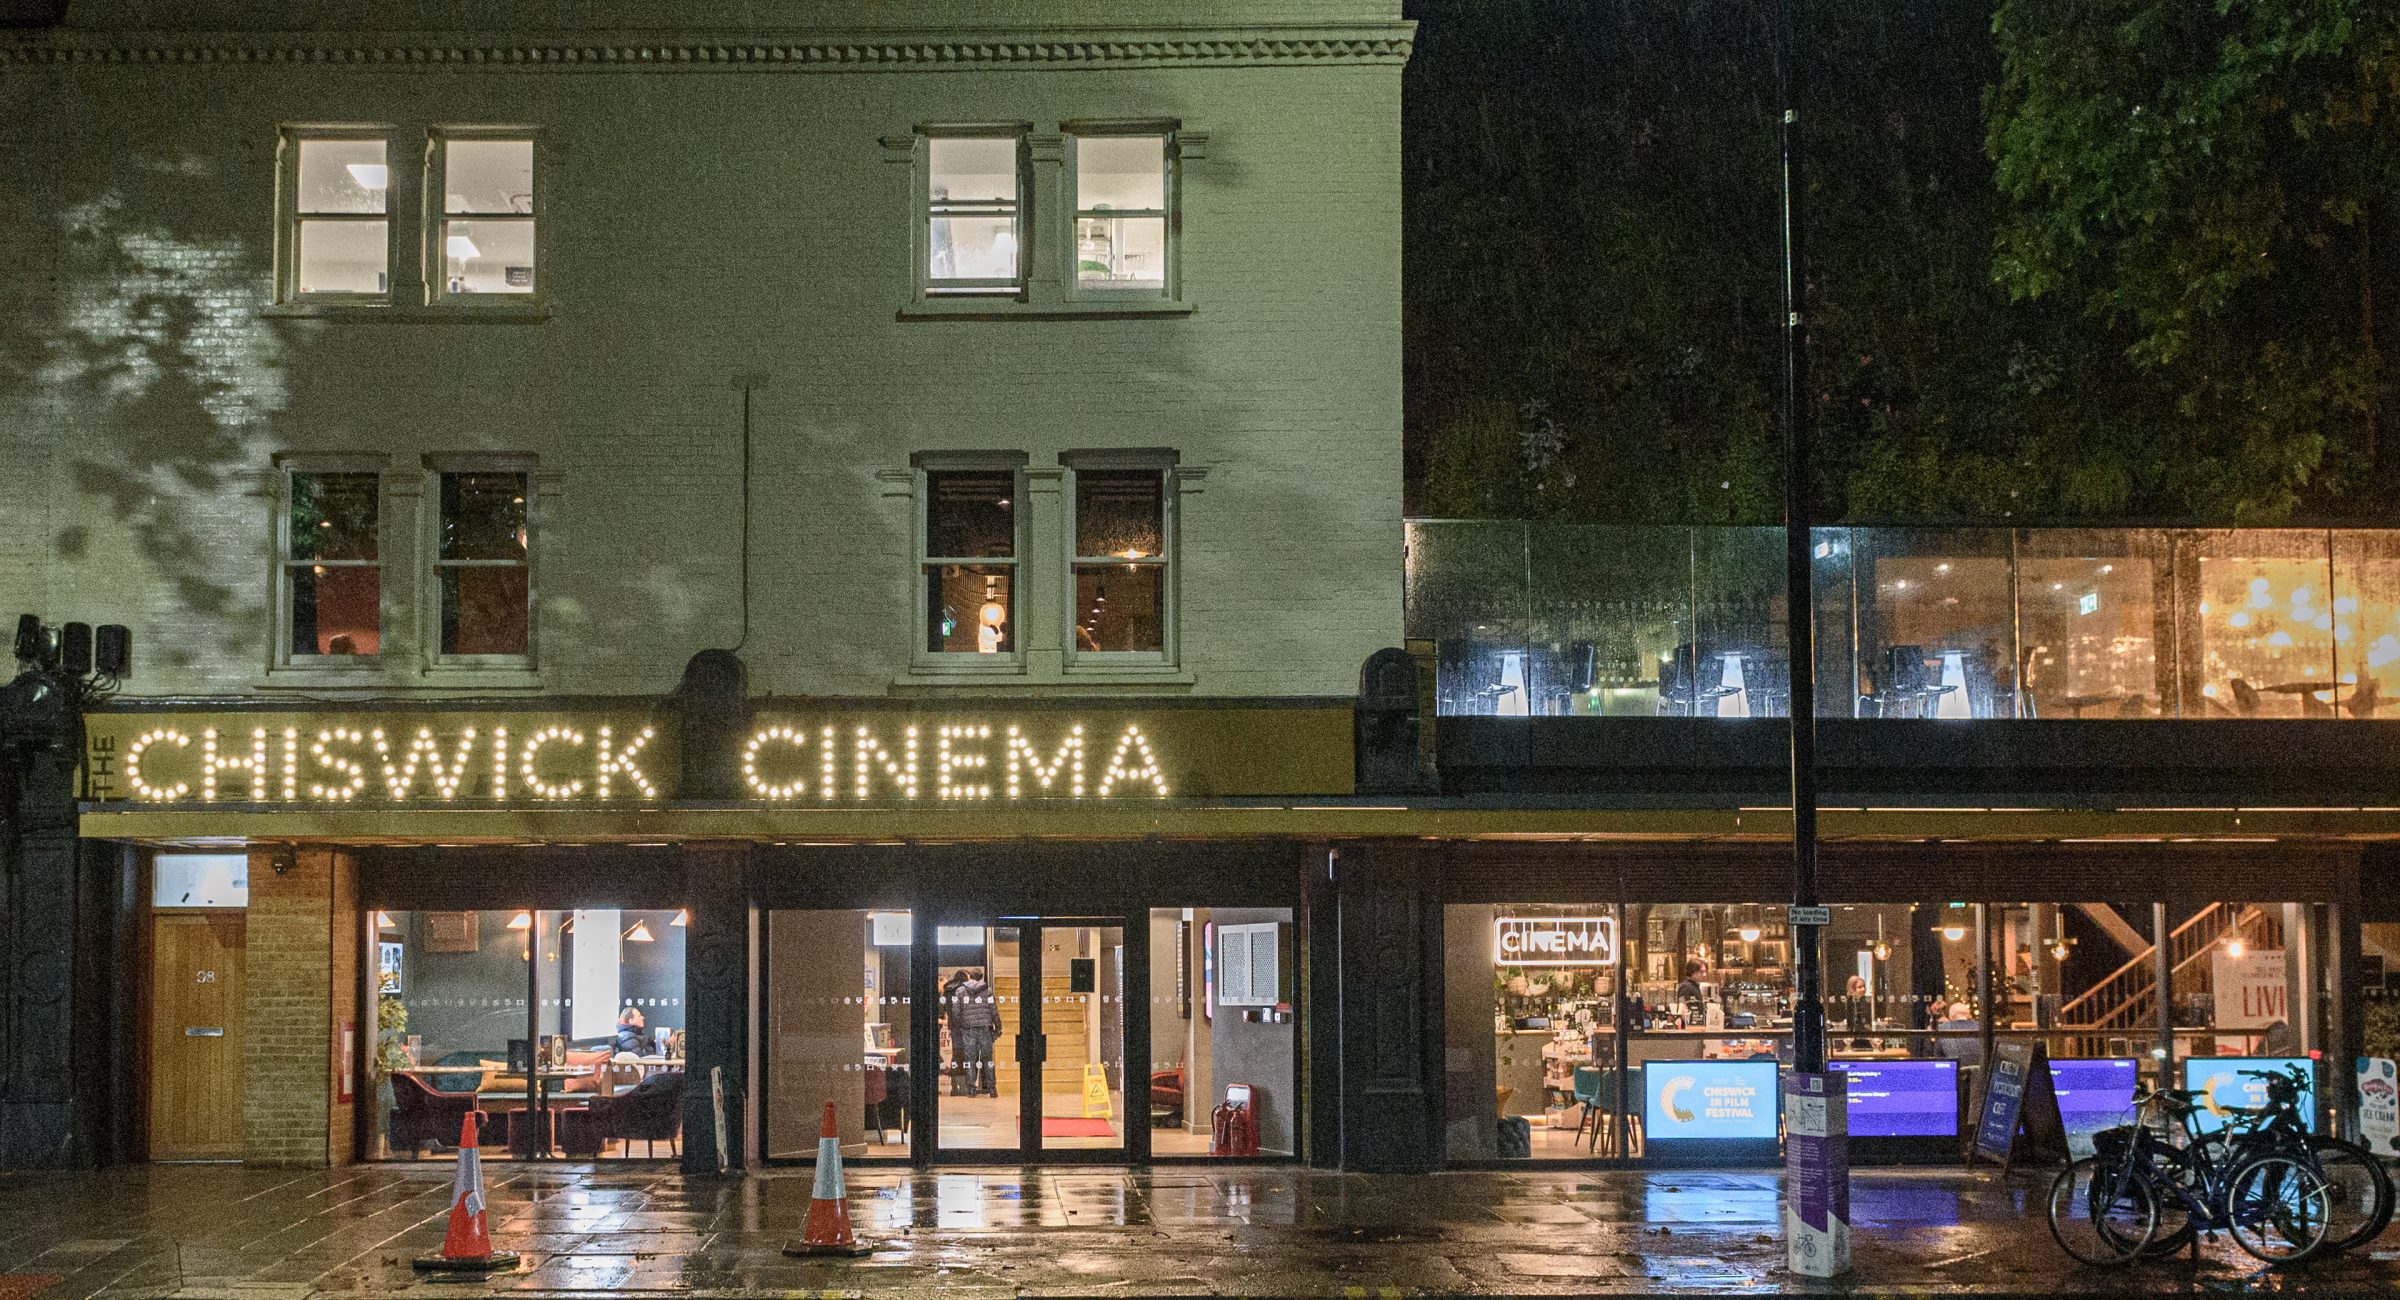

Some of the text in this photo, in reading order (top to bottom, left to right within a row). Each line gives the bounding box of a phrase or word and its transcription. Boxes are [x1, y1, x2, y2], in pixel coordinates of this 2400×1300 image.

[92, 735, 115, 799] THE
[124, 725, 1170, 798] CHISWICK CINEMA
[1501, 930, 1610, 953] CINEMA
[1703, 1086, 1757, 1097] CHISWICK
[1710, 1097, 1722, 1107] IN
[1705, 1107, 1755, 1118] FESTIVAL
